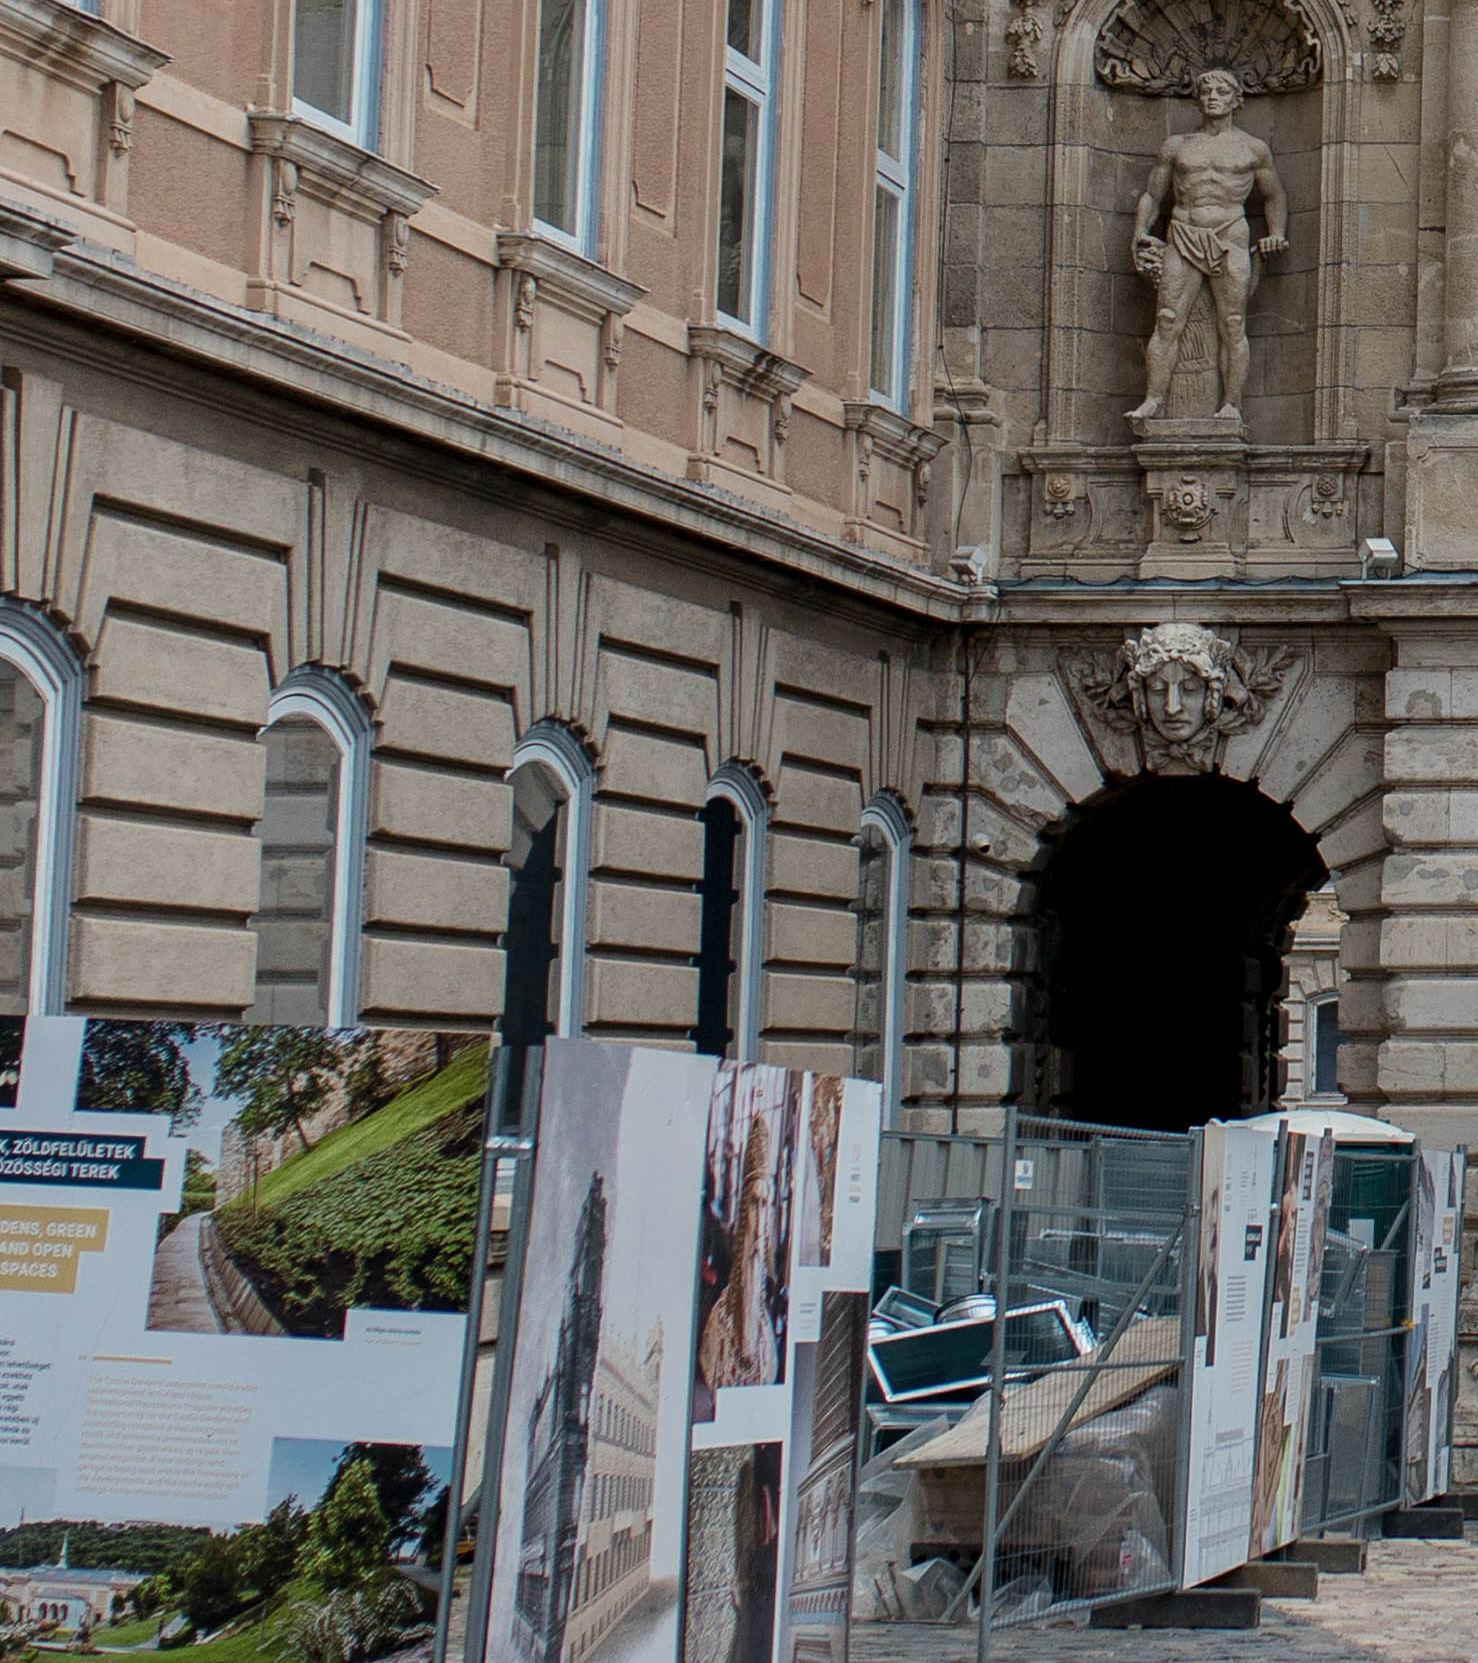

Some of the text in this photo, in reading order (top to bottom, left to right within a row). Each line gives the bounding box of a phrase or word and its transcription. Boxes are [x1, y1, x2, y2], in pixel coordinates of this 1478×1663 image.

[12, 1136, 137, 1160] ZÖLDFELÜLETEK
[70, 1162, 121, 1180] TEREK
[46, 1222, 98, 1239] GREEN
[0, 1240, 74, 1259] AND OPEN
[0, 1261, 58, 1278] SPACES
